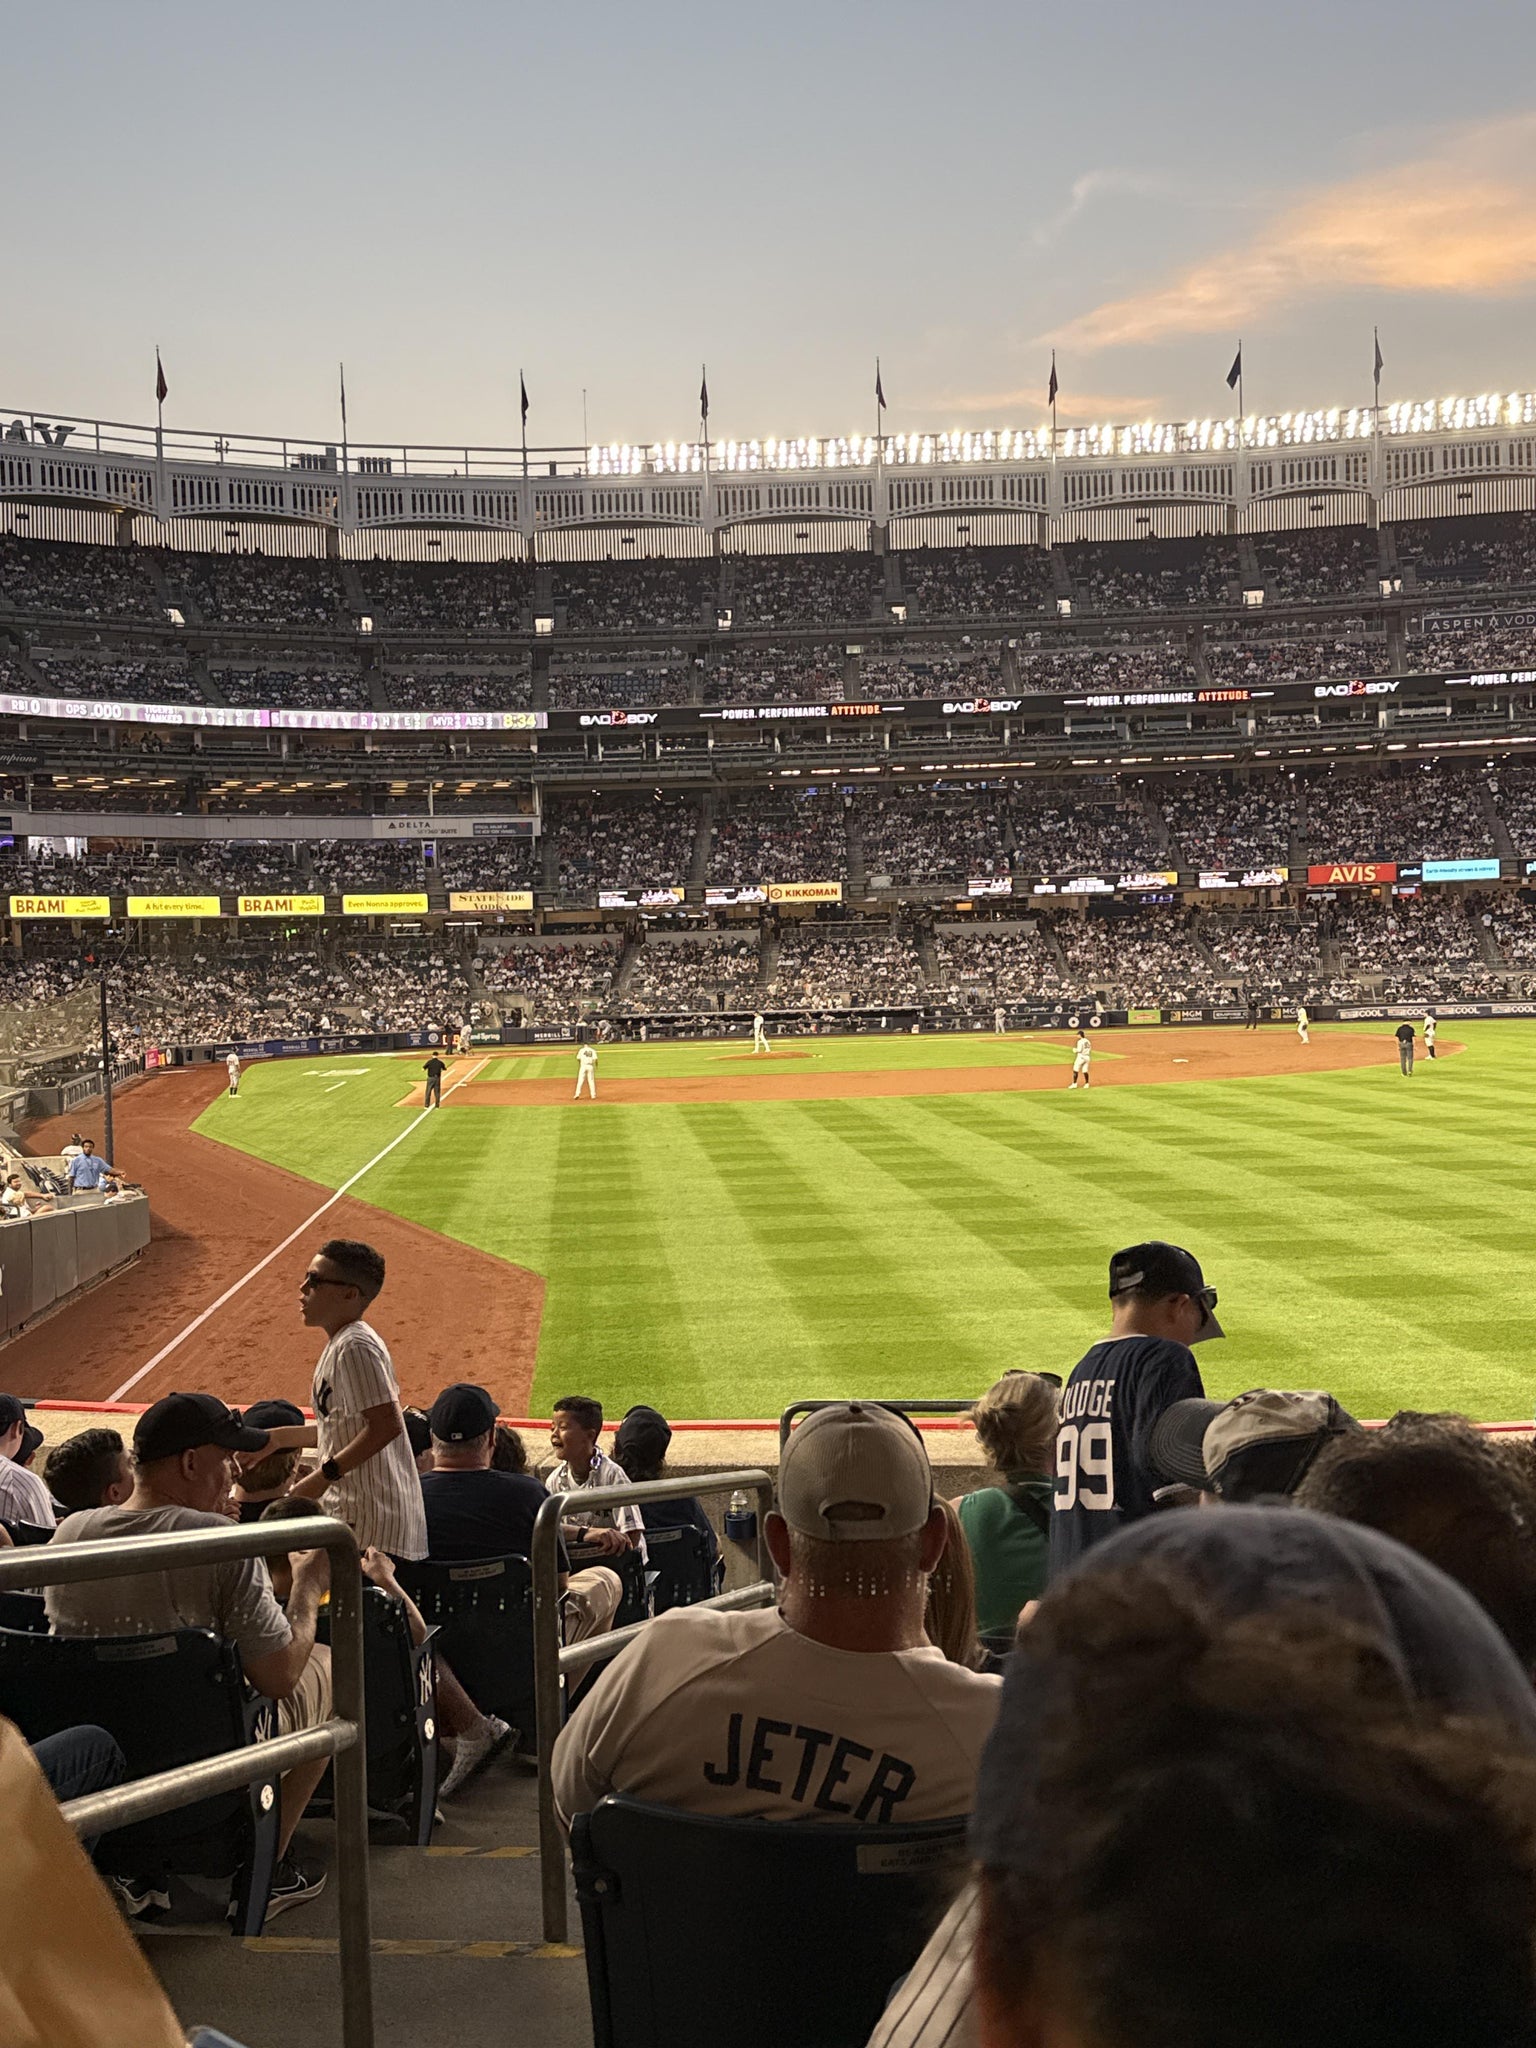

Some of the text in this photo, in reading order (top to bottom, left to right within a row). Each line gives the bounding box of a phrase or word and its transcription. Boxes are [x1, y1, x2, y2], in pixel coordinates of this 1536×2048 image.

[1430, 618, 1484, 631] ASPEN
[1470, 673, 1510, 686] POWER.
[1314, 681, 1400, 698] BAD BOY
[1086, 690, 1251, 707] POWER. PERFORMANCE. ATTITUDE.
[11, 699, 41, 714] RBI 0
[65, 703, 122, 719] OPS .000
[722, 708, 757, 720] POWER.
[758, 706, 829, 719] PERFORMANCE.
[942, 700, 1022, 714] BAD BOY
[404, 716, 411, 726] E
[465, 716, 485, 726] ABS
[502, 713, 537, 728] 8:34
[580, 713, 659, 726] BAD BOY
[398, 821, 431, 829] DELTA
[1328, 866, 1377, 883] AVIS
[458, 894, 525, 902] STATESIDE
[785, 888, 838, 897] KIKKOMAN
[15, 899, 66, 914] BRAMI
[243, 899, 293, 912] BRAMI
[474, 903, 511, 911] VODKA
[1358, 1009, 1384, 1018] COOL
[1454, 1006, 1480, 1014] COOL
[1510, 1005, 1536, 1013] COOL
[1058, 1379, 1116, 1425] JUDGE
[1054, 1421, 1115, 1511] 99
[703, 1712, 917, 1824] JETER
